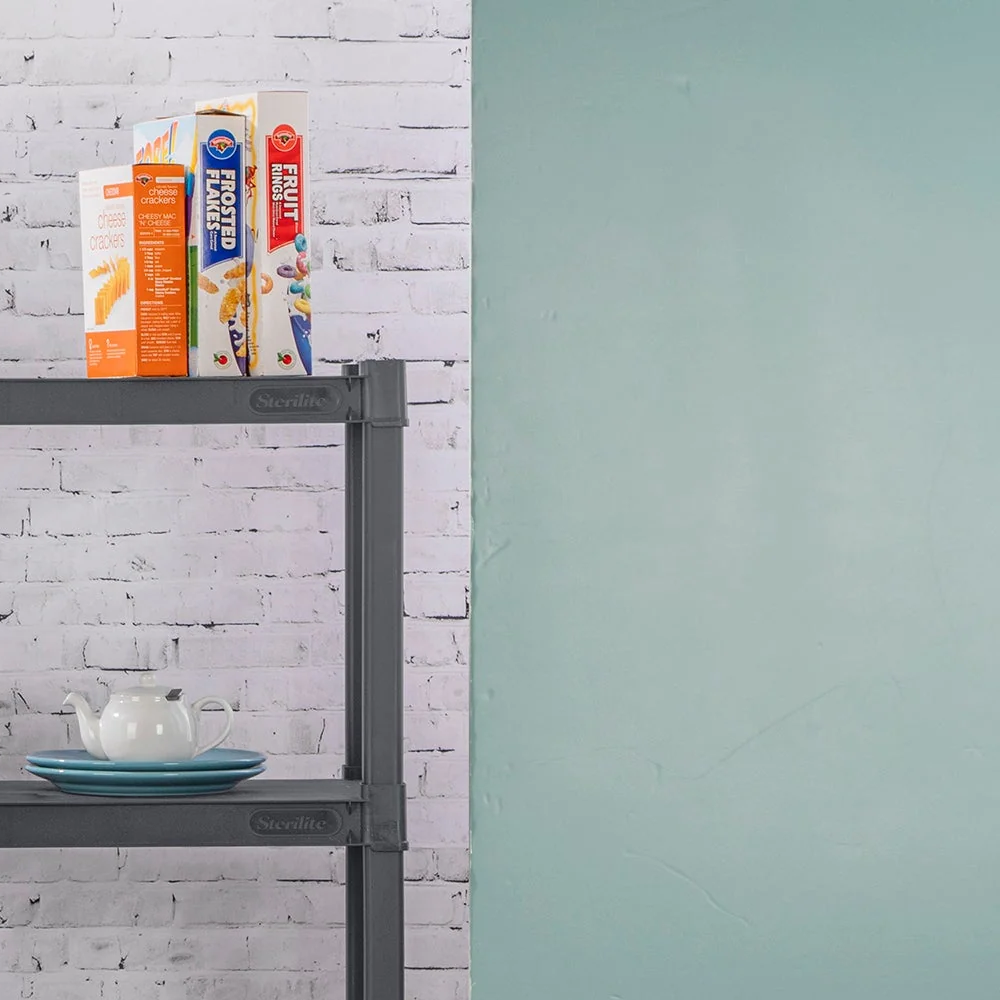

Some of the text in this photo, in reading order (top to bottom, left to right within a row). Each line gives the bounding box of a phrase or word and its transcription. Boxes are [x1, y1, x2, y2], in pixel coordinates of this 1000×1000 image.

[148, 187, 178, 197] cheese
[271, 163, 283, 202] RINGS
[140, 196, 176, 205] crackers
[205, 168, 220, 232] FLAKES
[283, 164, 299, 222] FRUIT
[97, 209, 126, 229] cheese
[220, 168, 236, 251] FROSTED
[89, 231, 125, 251] crackers
[257, 815, 327, 830] Sterilite
